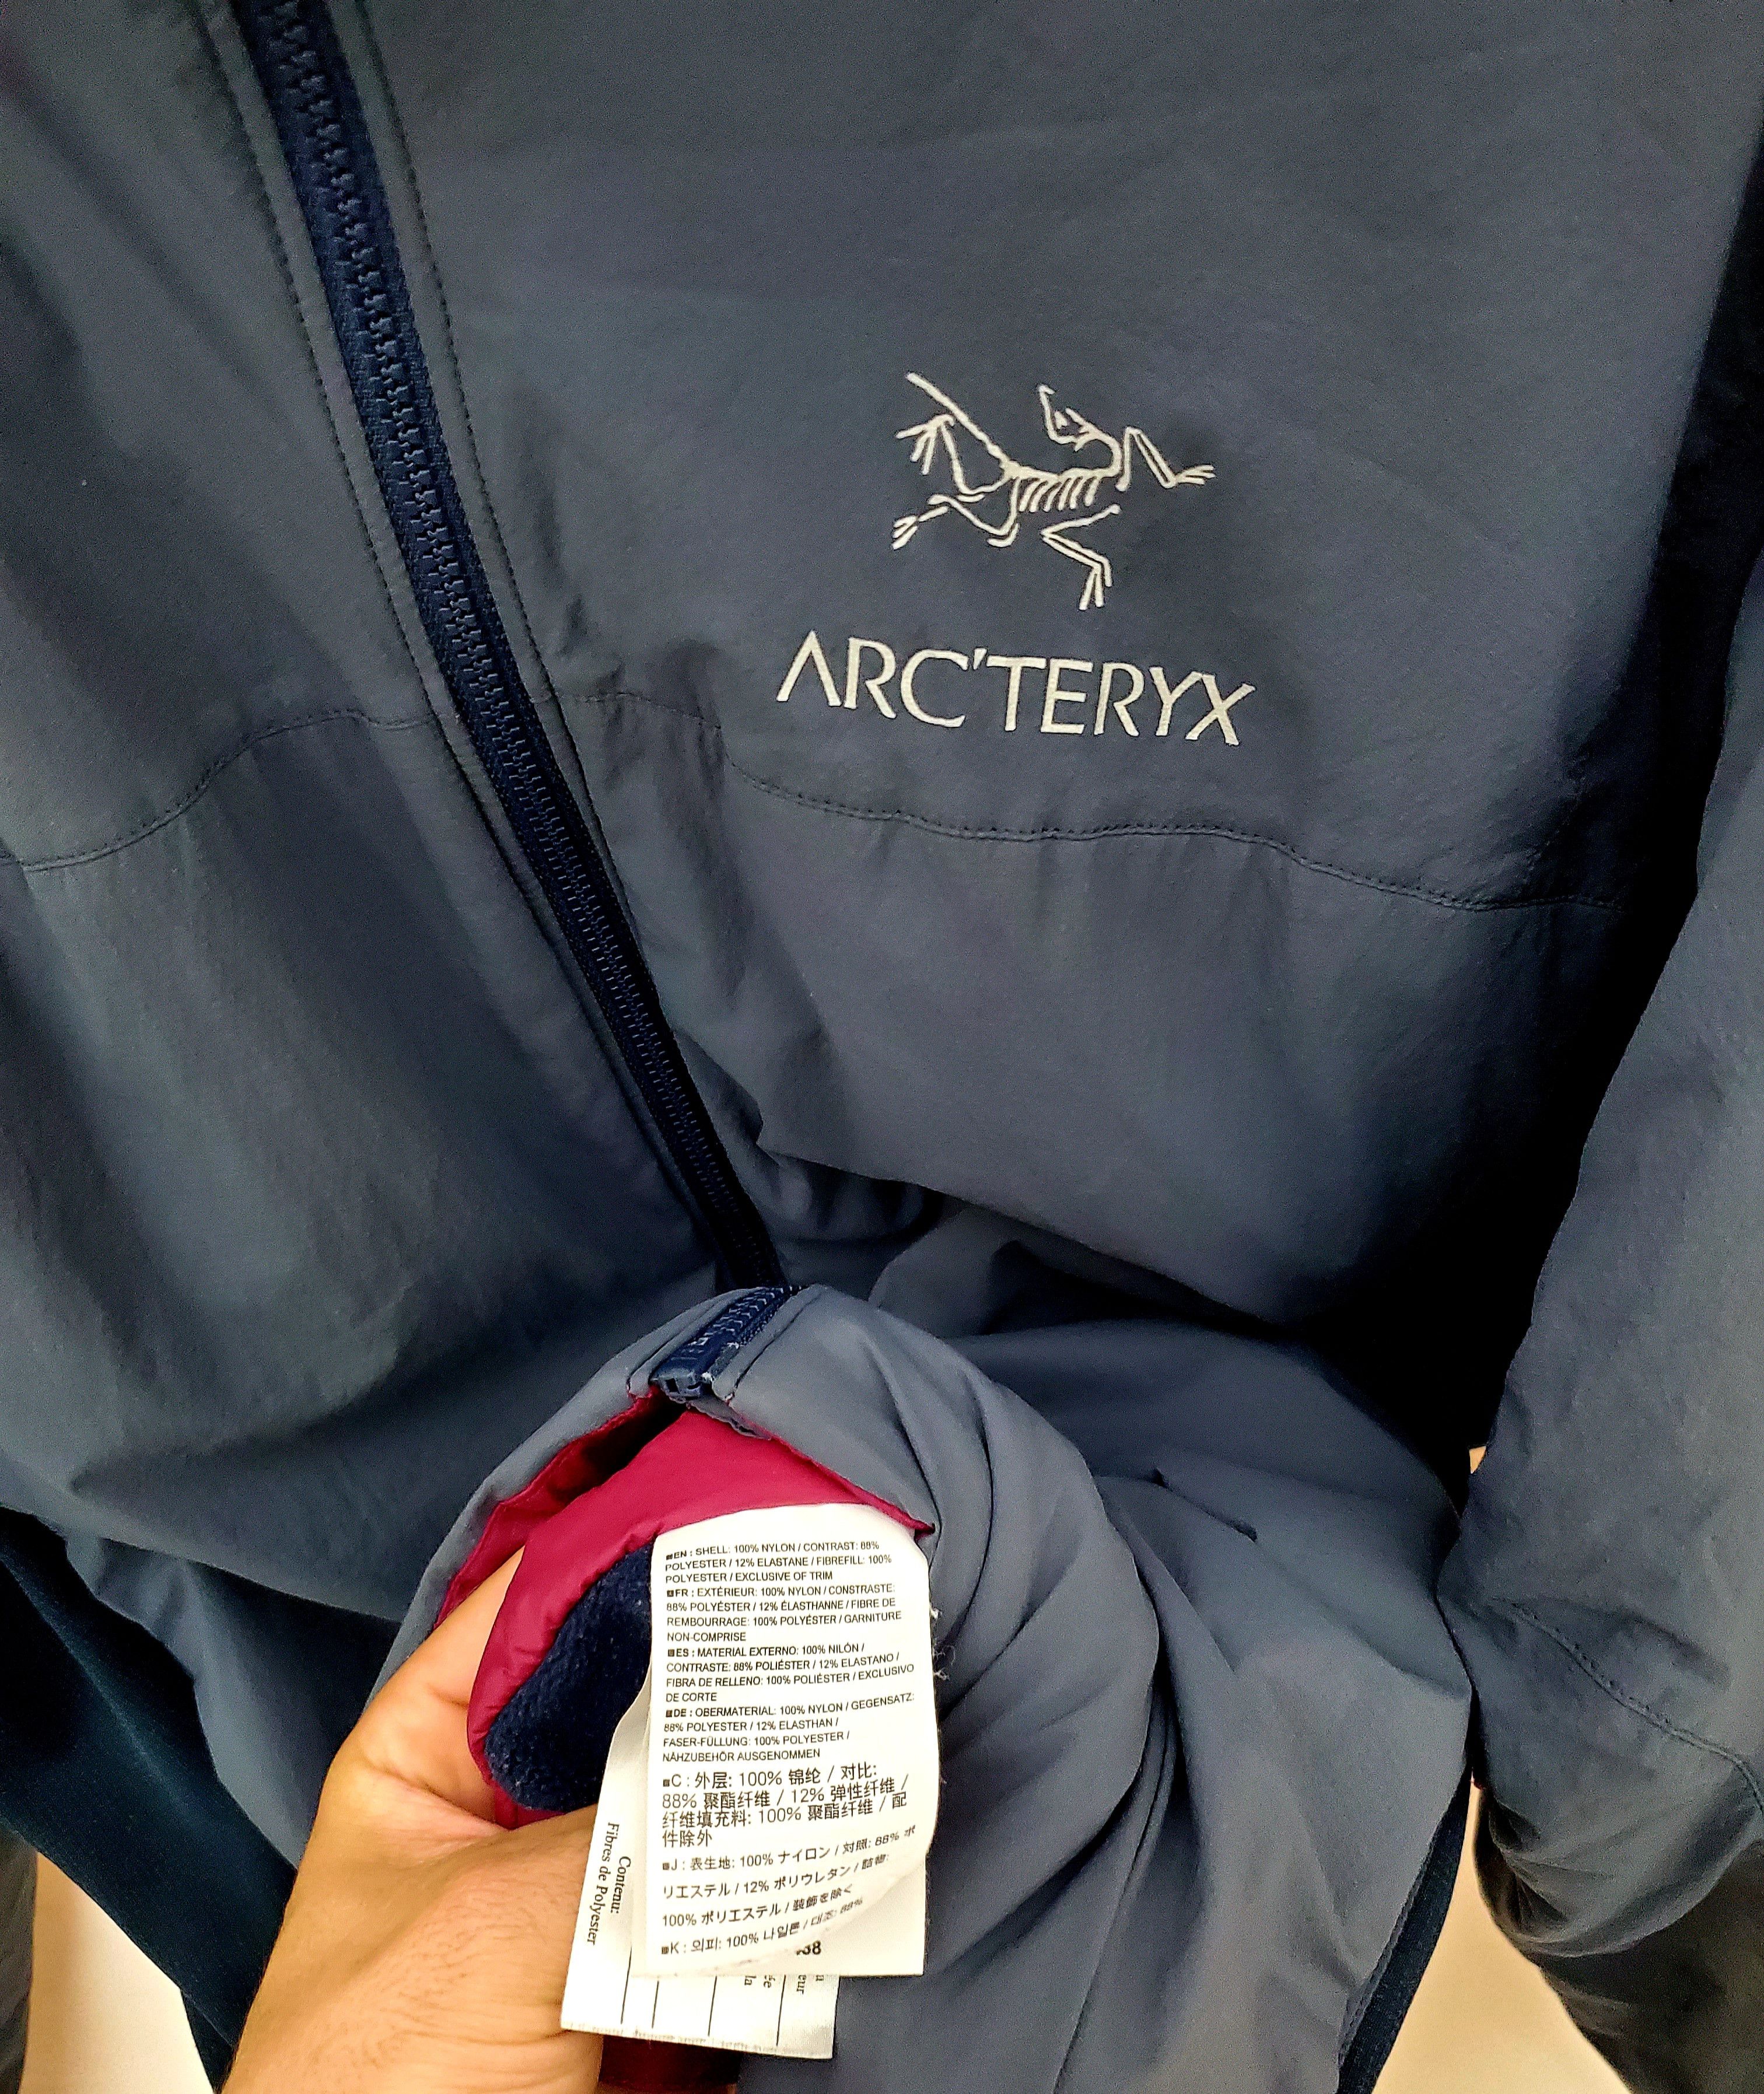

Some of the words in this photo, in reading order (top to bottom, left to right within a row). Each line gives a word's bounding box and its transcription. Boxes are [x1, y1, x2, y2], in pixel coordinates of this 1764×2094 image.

[776, 630, 1255, 746] ARC'TERYX
[674, 1550, 687, 1559] EN
[695, 1545, 731, 1556] SHELL:
[734, 1544, 759, 1553] 100%
[762, 1543, 795, 1552] NYLON
[803, 1542, 858, 1552] CONTRAST:
[860, 1541, 879, 1550] 88%
[665, 1559, 727, 1571] POLYESTER
[735, 1558, 754, 1567] 12%
[757, 1557, 808, 1567] ELASTANE
[817, 1555, 864, 1566] FIBREFILL:
[869, 1554, 892, 1564] 100%
[666, 1573, 727, 1584] POLYESTER
[736, 1571, 790, 1582] EXCLUSIVE
[793, 1571, 807, 1581] OF
[810, 1571, 833, 1580] TRIM
[676, 1589, 688, 1597] FR
[697, 1585, 757, 1597] EXTÉRIEUR:
[761, 1587, 785, 1596] 100%
[788, 1586, 821, 1596] NYLON
[828, 1583, 895, 1595] CONSTRASTE:
[666, 1602, 687, 1612] 88%
[690, 1601, 751, 1612] POLYÉSTER
[759, 1602, 778, 1611] 12%
[781, 1600, 844, 1611] ÉLASTHANNE
[851, 1599, 879, 1609] FIBRE
[882, 1598, 896, 1608] DE
[667, 1617, 750, 1627] REMBOURRAGE:
[753, 1616, 778, 1626] 100%
[780, 1614, 836, 1626] POLYÉSTER
[844, 1610, 902, 1624] GARNITURE
[667, 1632, 747, 1641] NON-COMPRISE
[676, 1648, 689, 1657] ES
[697, 1647, 747, 1657] MATERIAL
[749, 1645, 799, 1657] EXTERNO:
[802, 1644, 825, 1654] 100%
[828, 1642, 859, 1654] NILÓN
[666, 1662, 731, 1672] CONTRASTE:
[733, 1662, 753, 1671] 88%
[755, 1659, 810, 1671] POLIÉSTER
[819, 1659, 838, 1669] 12%
[841, 1653, 894, 1668] ELASTANO
[666, 1678, 696, 1687] FIBRA
[698, 1678, 713, 1687] DE
[715, 1676, 763, 1686] RELLENO:
[766, 1675, 790, 1685] 100%
[793, 1672, 850, 1685] POLIÉSTER
[858, 1664, 914, 1680] EXCLUSIVO
[666, 1693, 680, 1702] DE
[682, 1692, 718, 1702] CORTE
[674, 1708, 687, 1717] DE
[695, 1706, 776, 1717] OBERMATERIAL:
[780, 1705, 805, 1715] 100%
[808, 1702, 843, 1714] NYLON
[851, 1692, 915, 1710] GEGENSATZ:
[664, 1723, 684, 1732] 88%
[687, 1721, 747, 1732] POLYESTER
[757, 1721, 776, 1731] 12%
[779, 1718, 832, 1730] ELASTHAN
[754, 1736, 780, 1746] 100%
[783, 1731, 844, 1745] POLYESTER
[737, 1748, 820, 1761] AUSGENOMMEN
[671, 1774, 681, 1787] C
[695, 1771, 732, 1790] 外层:
[739, 1770, 782, 1787] 100%
[841, 1761, 877, 1780] 对比:
[662, 1793, 697, 1809] 88%
[703, 1790, 771, 1810] 聚酯纤维
[792, 1787, 824, 1803] 12%
[830, 1777, 895, 1801] 弹性纤维
[662, 1809, 751, 1829] 纤维填充料:
[759, 1806, 801, 1824] 100%
[808, 1798, 873, 1821] 聚酯纤维
[892, 1791, 907, 1809] 配
[601, 1822, 620, 1862] Fibres
[662, 1829, 712, 1848] 件除外
[671, 1858, 677, 1871] J
[690, 1855, 735, 1871] 表生地:
[740, 1852, 774, 1867] 100%
[778, 1847, 830, 1864] ナイロン
[598, 1866, 611, 1881] de
[663, 1882, 731, 1899] リエステル
[744, 1880, 769, 1894] 12%
[774, 1866, 851, 1890] ポリウレタン
[610, 1856, 631, 1914] Contenu:
[587, 1885, 609, 1946] Polyester
[662, 1913, 697, 1927] 100%
[702, 1903, 781, 1925] ポリエステル
[671, 1941, 680, 1954] K
[727, 1932, 759, 1948] 100%
